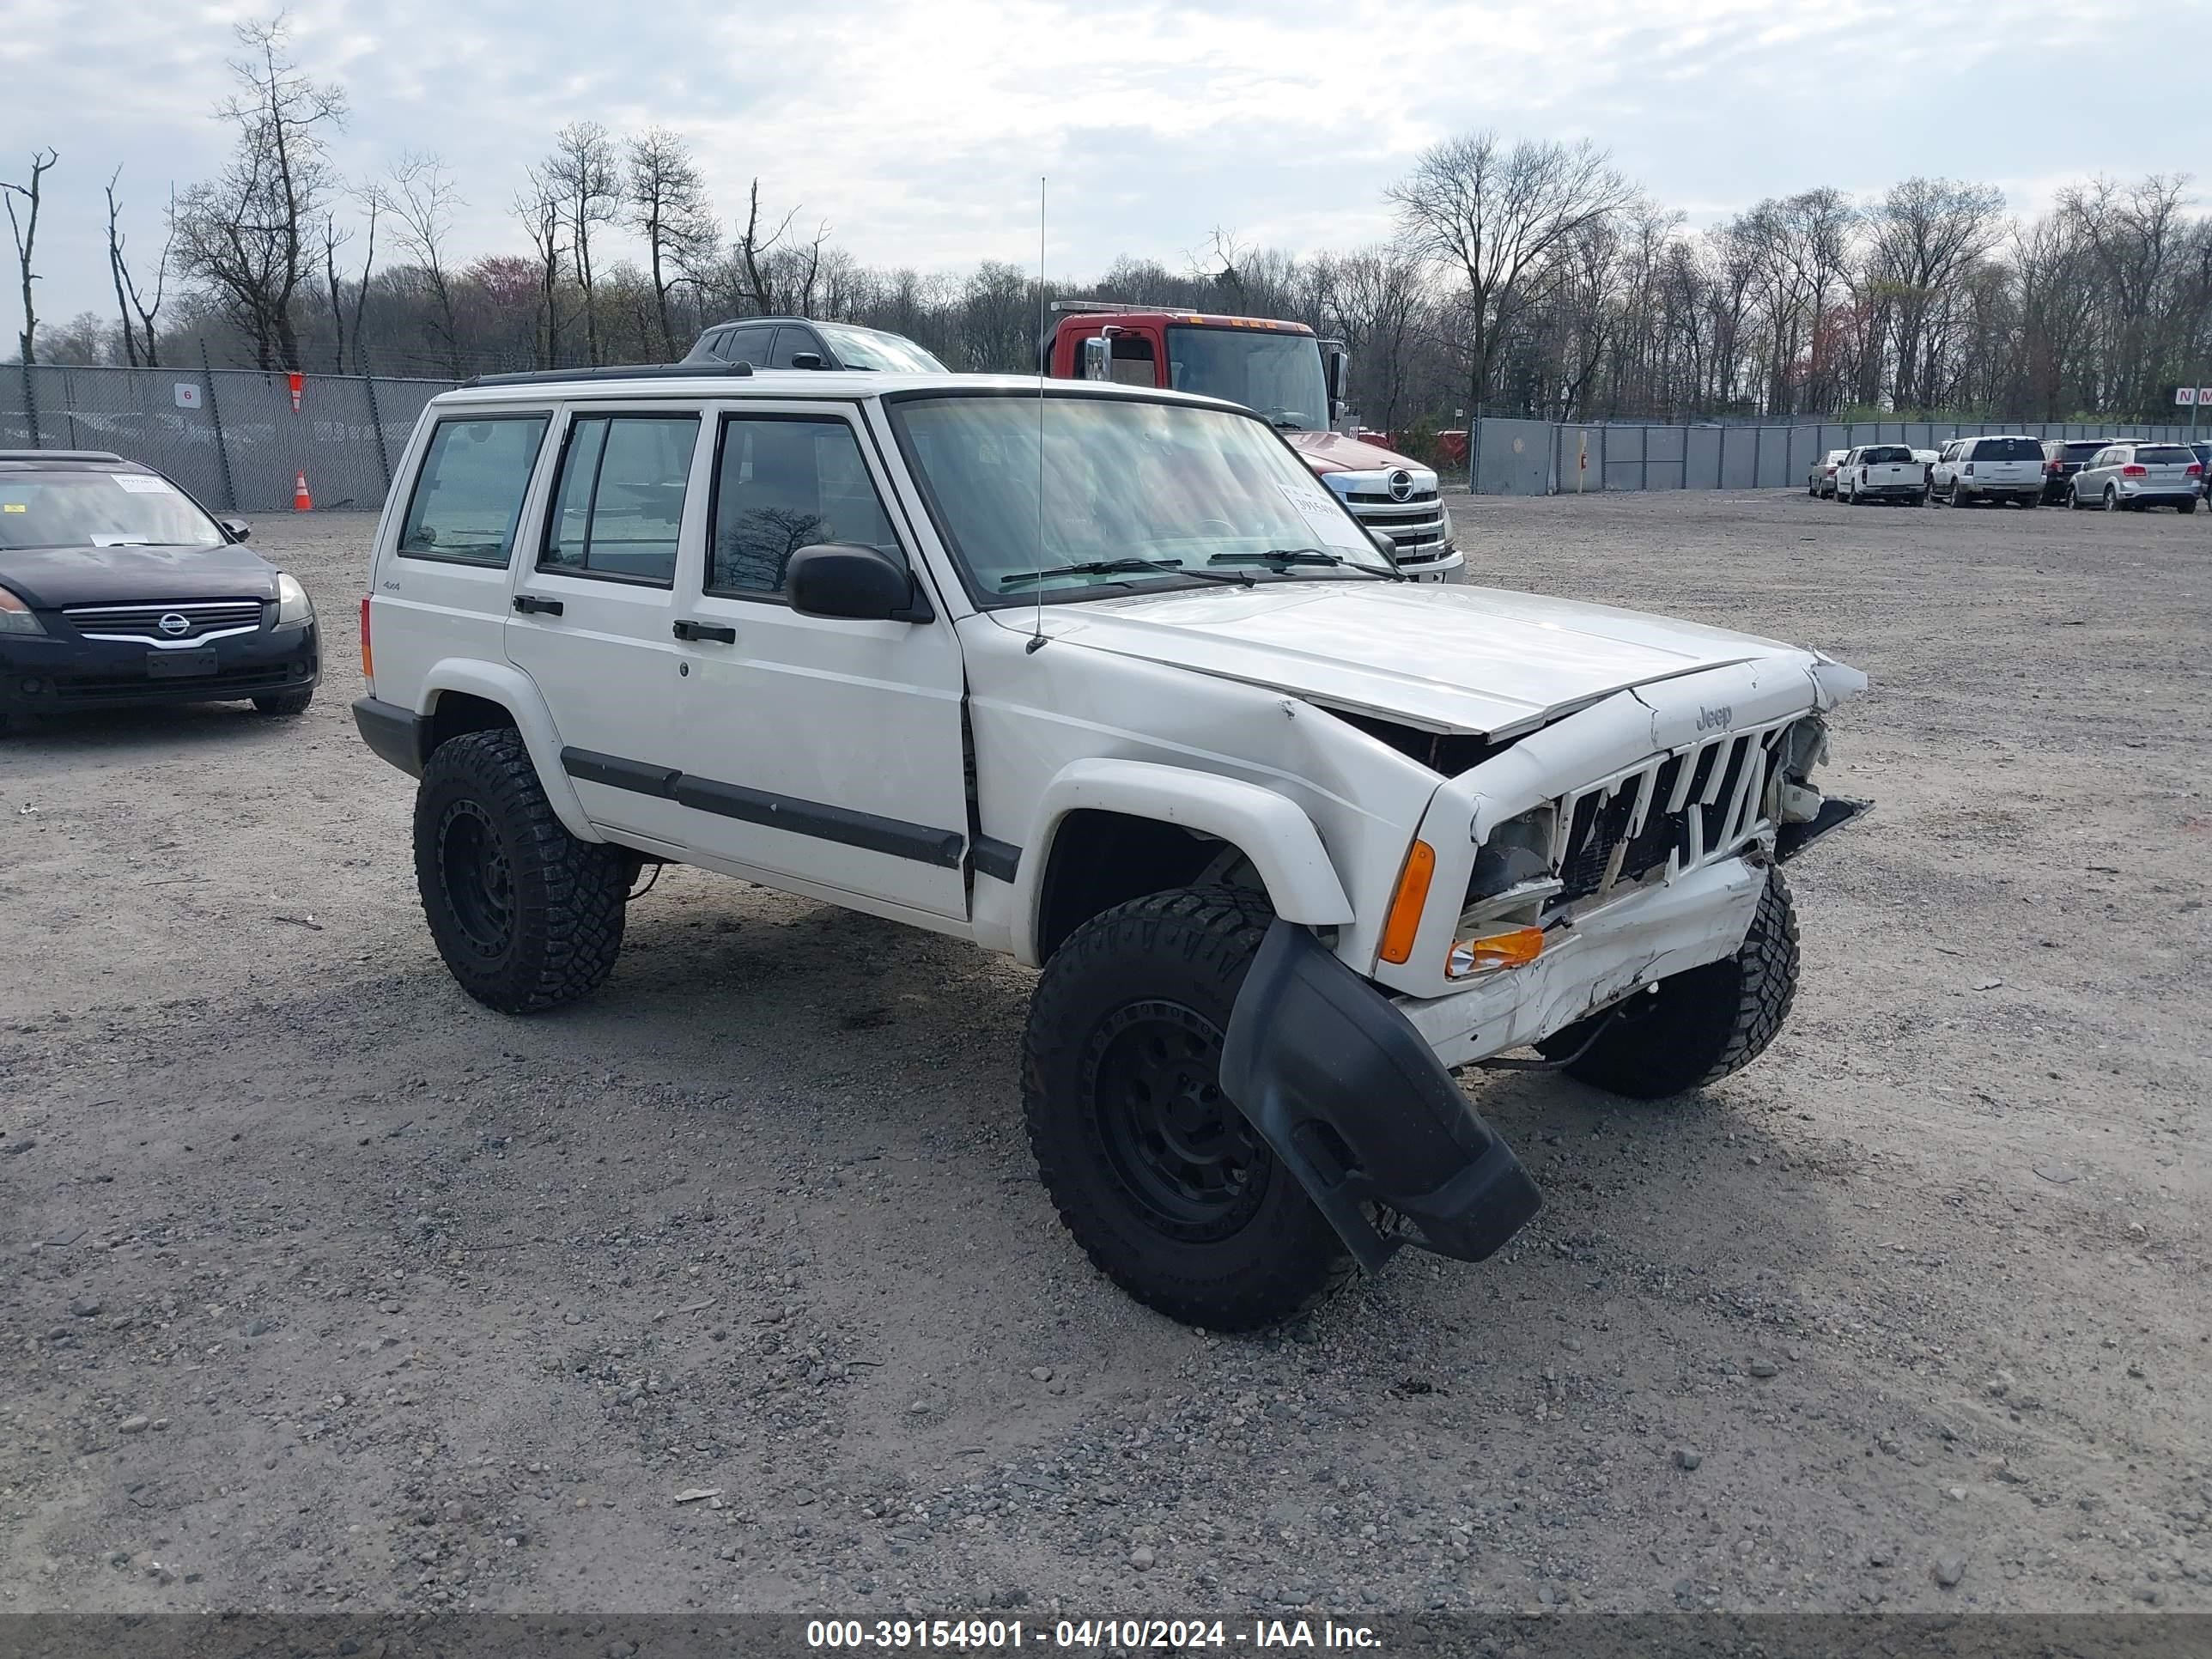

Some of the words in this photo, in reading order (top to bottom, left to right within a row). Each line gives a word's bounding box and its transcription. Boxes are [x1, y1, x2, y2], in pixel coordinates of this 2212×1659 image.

[184, 391, 192, 400] 6
[2179, 391, 2191, 401] N
[1697, 706, 1732, 731] Jeep
